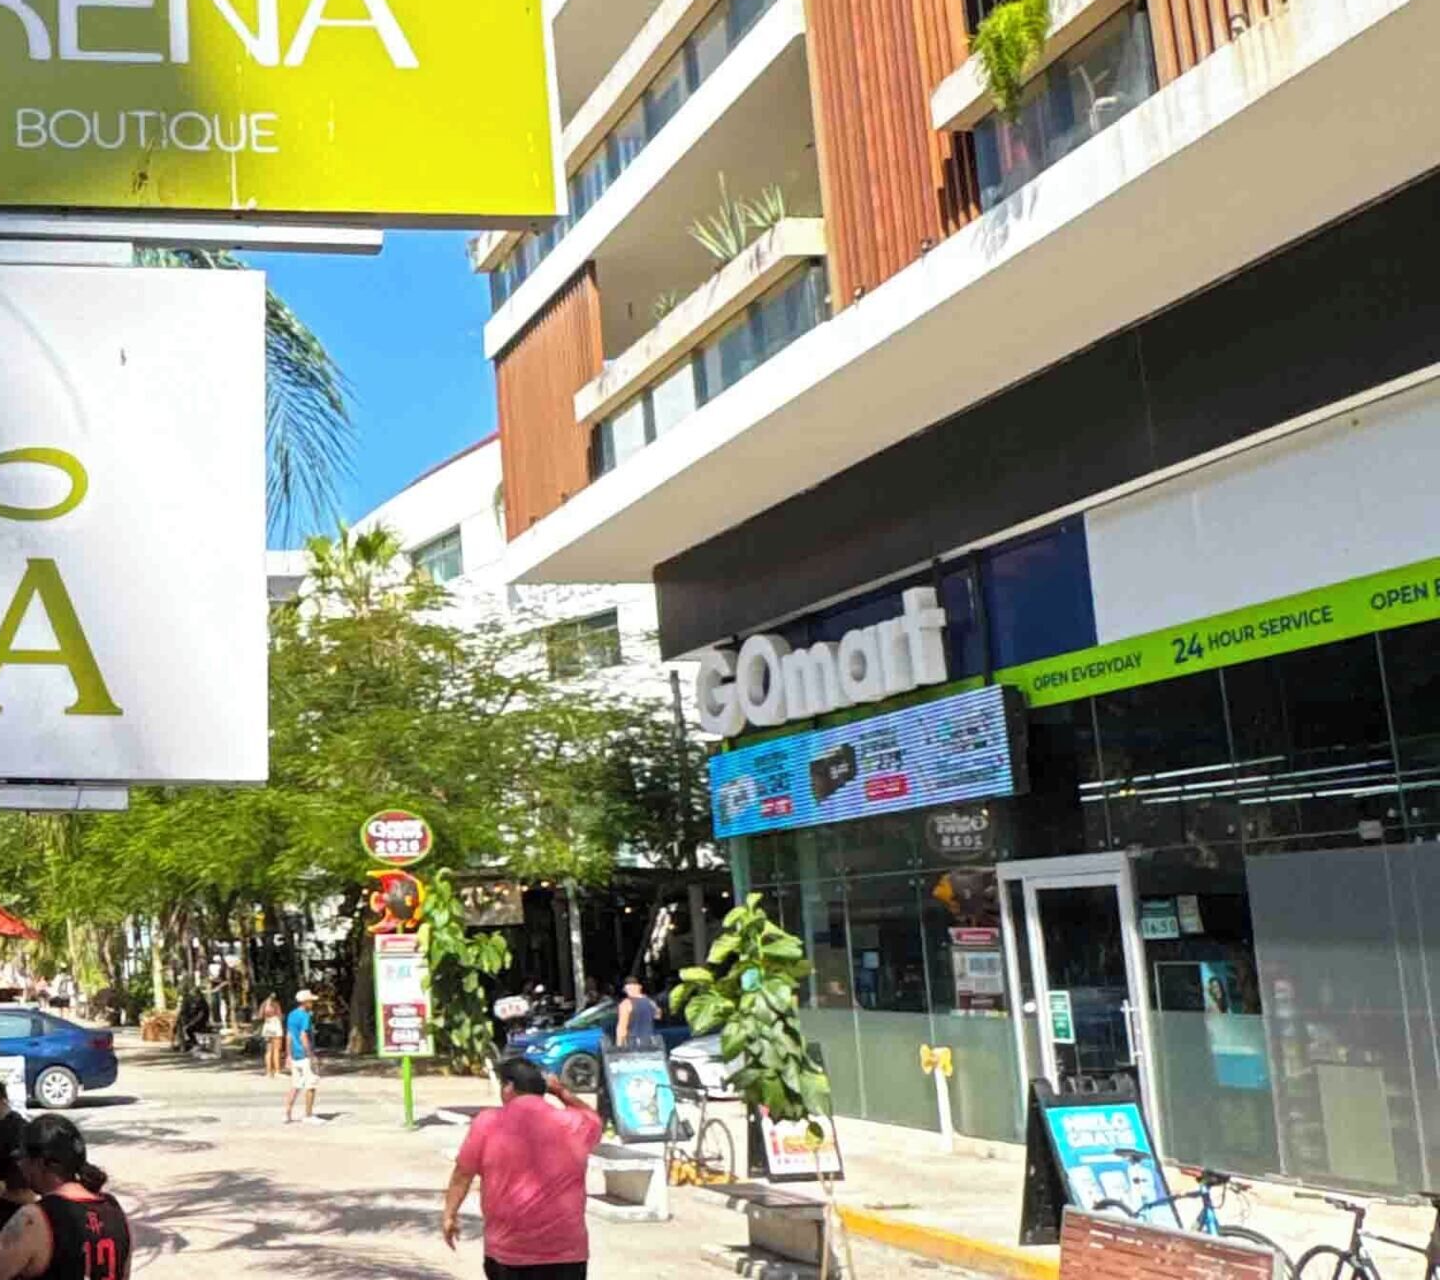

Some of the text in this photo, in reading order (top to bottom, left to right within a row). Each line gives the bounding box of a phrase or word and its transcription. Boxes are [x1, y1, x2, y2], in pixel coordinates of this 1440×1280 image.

[15, 106, 280, 155] BOUTIQUE
[1369, 582, 1429, 611] OPEN
[1171, 605, 1334, 665] 24 HOUR SERVICE
[1033, 651, 1144, 692] OPEN EVERYDAY
